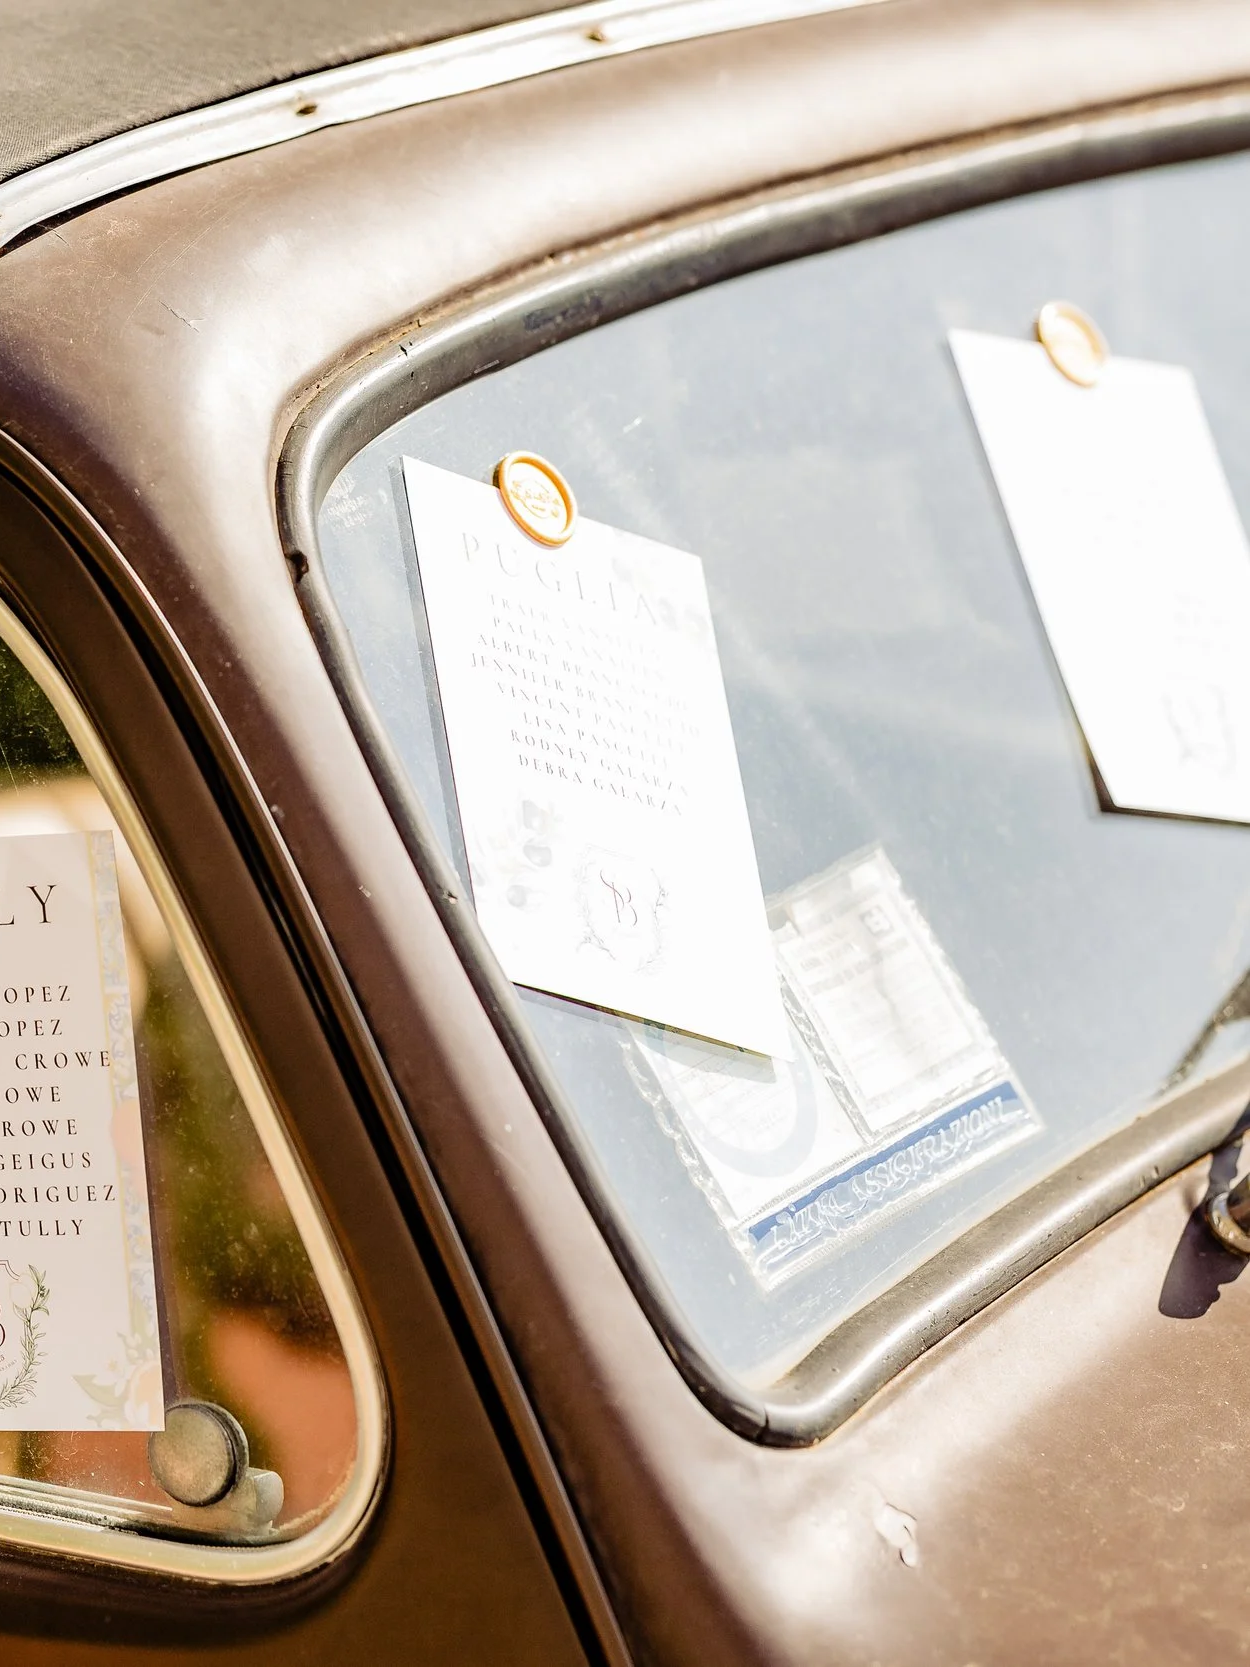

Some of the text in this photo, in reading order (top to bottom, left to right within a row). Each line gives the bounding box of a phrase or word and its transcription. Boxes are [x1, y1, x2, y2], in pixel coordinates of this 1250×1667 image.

[462, 532, 656, 625] PUGLIA
[478, 633, 549, 666] ALBERT
[470, 653, 566, 692] JENNIFER
[494, 680, 583, 719] VINCENT
[523, 712, 566, 736] LISA
[510, 729, 688, 796] RODNEY GALARZA
[518, 752, 682, 816] DEBRA GALARZA
[15, 1051, 110, 1070] CROWE
[0, 1220, 82, 1236] TULLY
